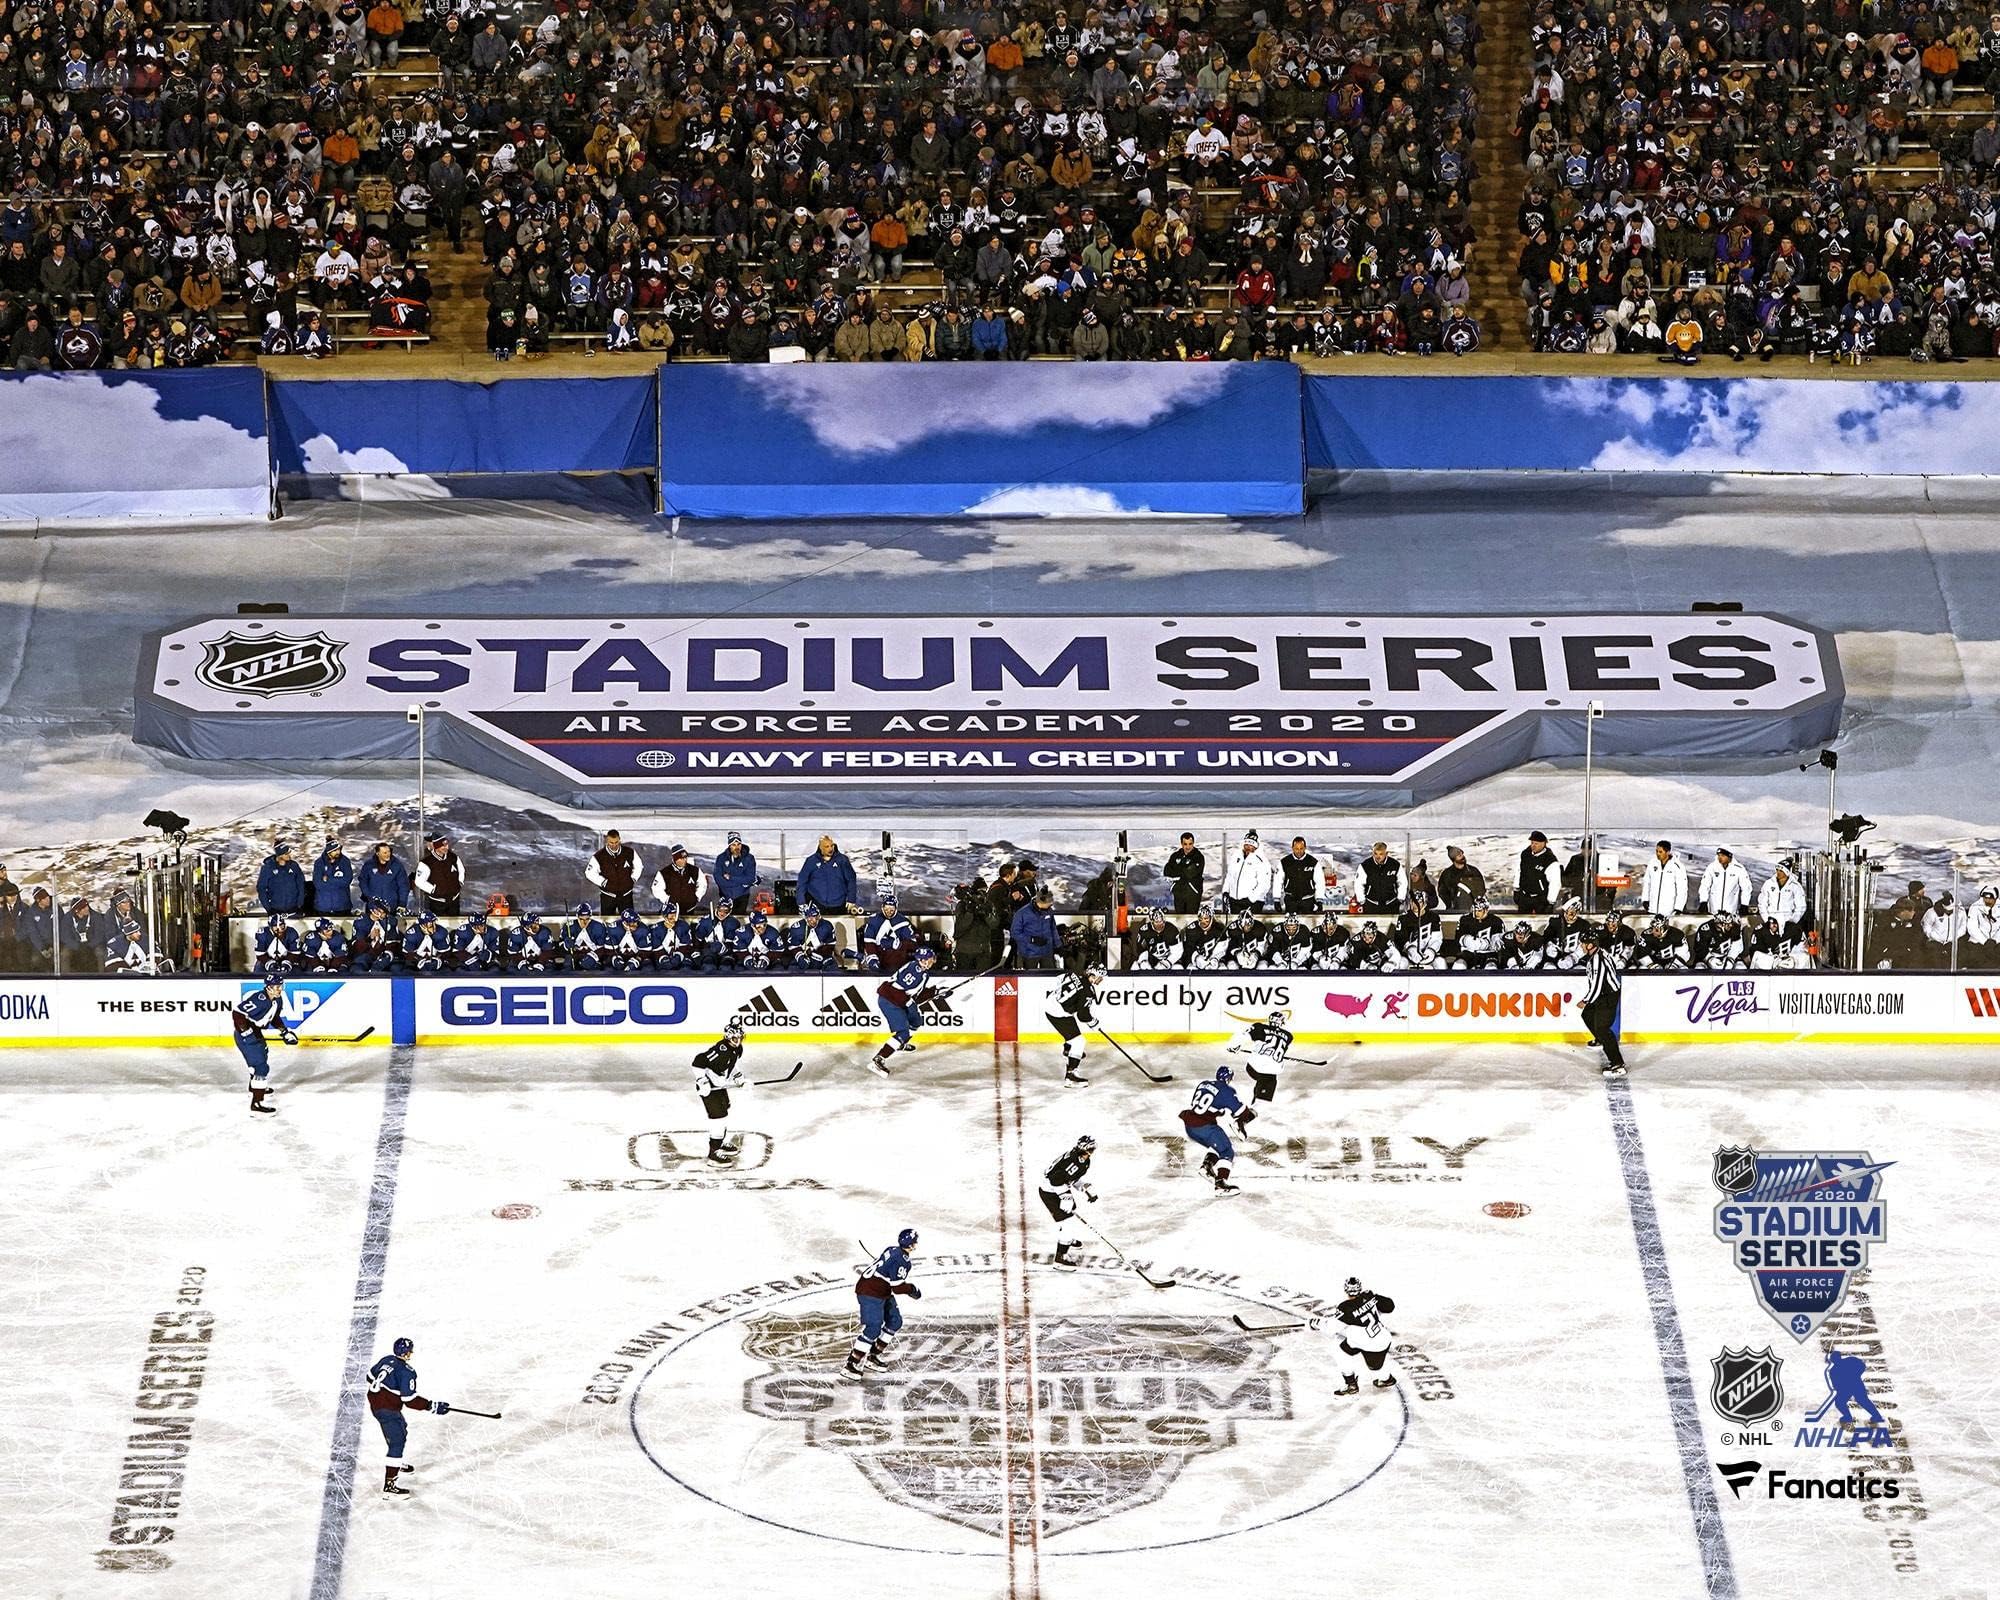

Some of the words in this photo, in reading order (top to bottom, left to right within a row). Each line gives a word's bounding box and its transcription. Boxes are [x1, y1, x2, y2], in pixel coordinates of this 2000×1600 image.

[231, 649, 315, 684] NHL
[366, 637, 1111, 693] STADIUM
[1155, 635, 1777, 692] SERIES
[563, 716, 648, 732] AIR
[681, 716, 852, 732] FORCE
[882, 715, 1141, 732] ACADEMY
[1228, 715, 1417, 732] 2020
[687, 751, 814, 769] NAVY
[822, 750, 1017, 769] FEDERAL
[1028, 750, 1185, 768] CREDIT
[1179, 985, 1213, 1012] by
[1226, 984, 1290, 1006] aws
[1728, 981, 1754, 996] LAS
[98, 1001, 135, 1013] THE
[141, 1000, 188, 1013] BEST
[194, 1000, 233, 1013] RUN
[441, 985, 689, 1026] GEICO
[1417, 992, 1572, 1018] DUNKIN'
[1676, 983, 1770, 1026] Vegas
[1779, 992, 1905, 1015] VISITLASVEGAS.COM
[730, 1011, 800, 1028] adidas
[812, 1011, 882, 1028] adidas
[562, 1178, 833, 1191] HONDA
[135, 1310, 216, 1410] SERIES
[109, 1416, 196, 1545] STADIUM
